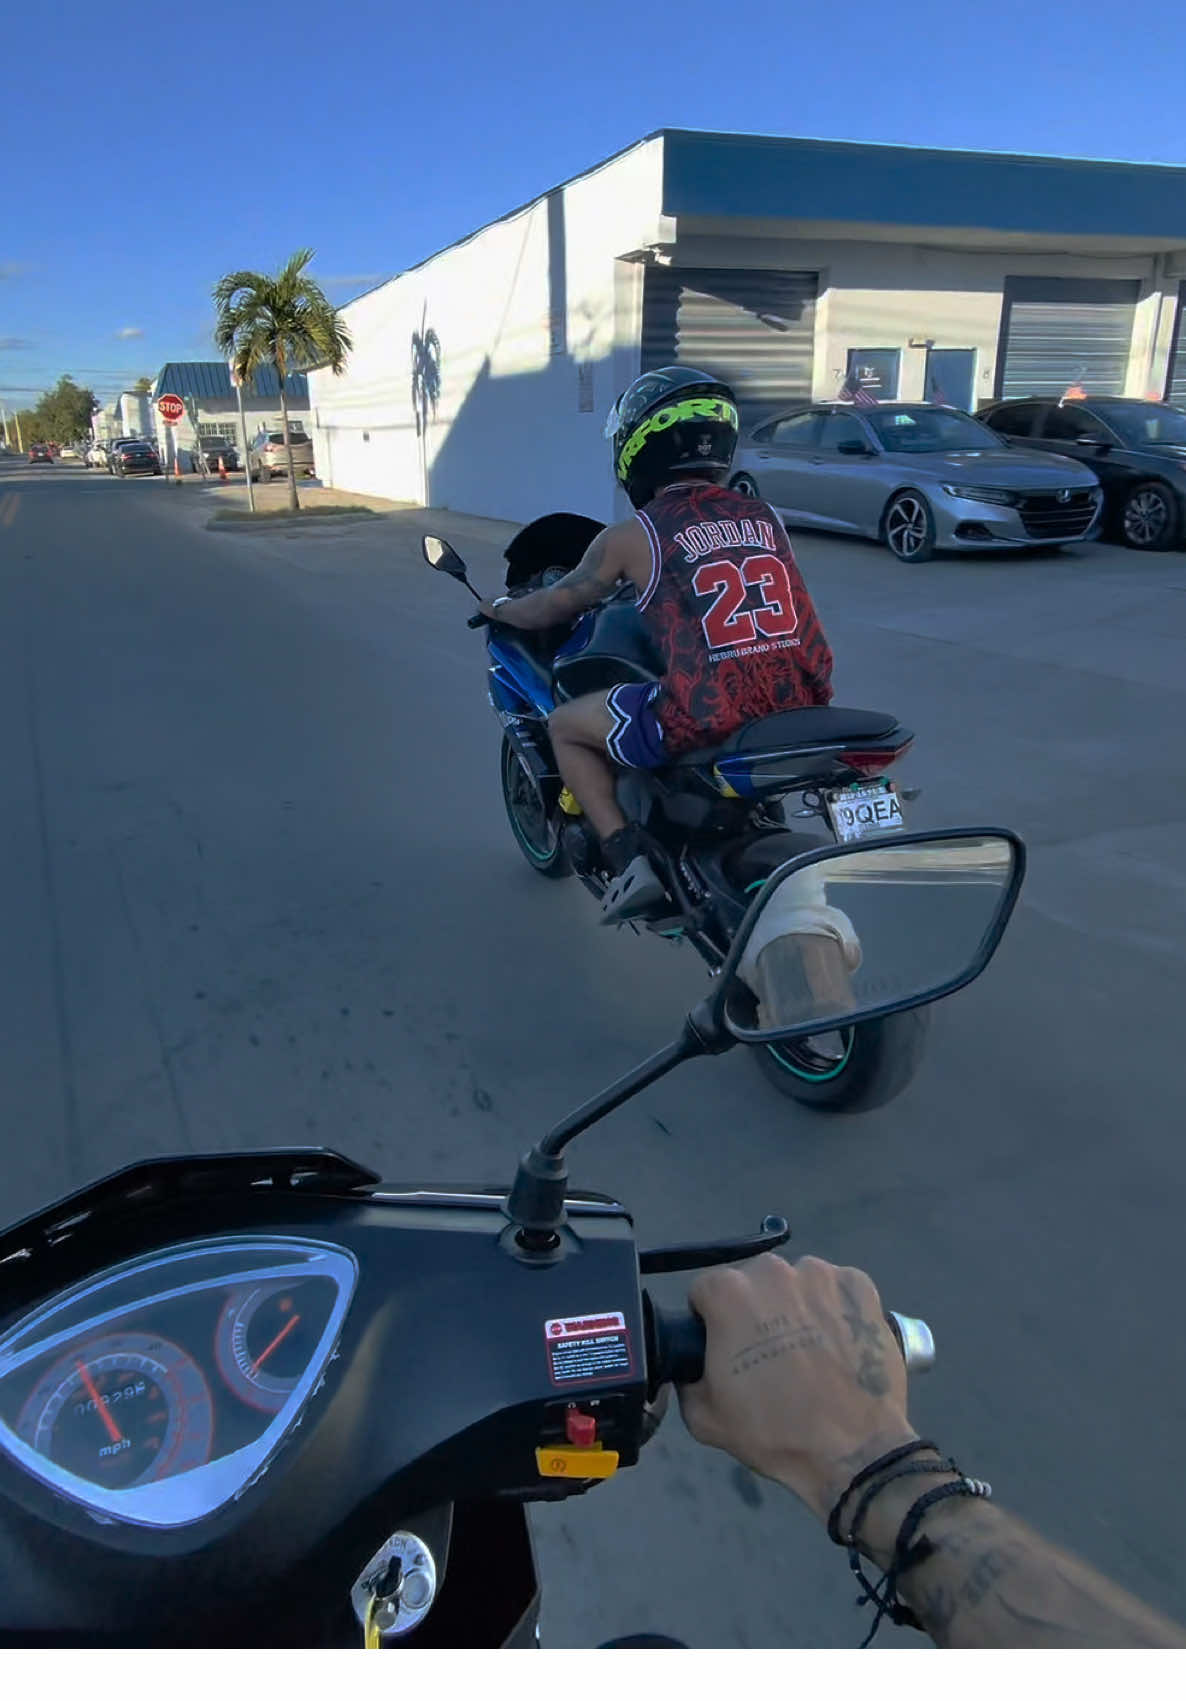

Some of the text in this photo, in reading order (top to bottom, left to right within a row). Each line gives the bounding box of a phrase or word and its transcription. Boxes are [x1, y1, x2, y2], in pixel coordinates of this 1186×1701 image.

[159, 401, 183, 413] STOP
[673, 519, 776, 563] JORDAN
[691, 553, 798, 649] 23
[98, 1439, 131, 1457] mph
